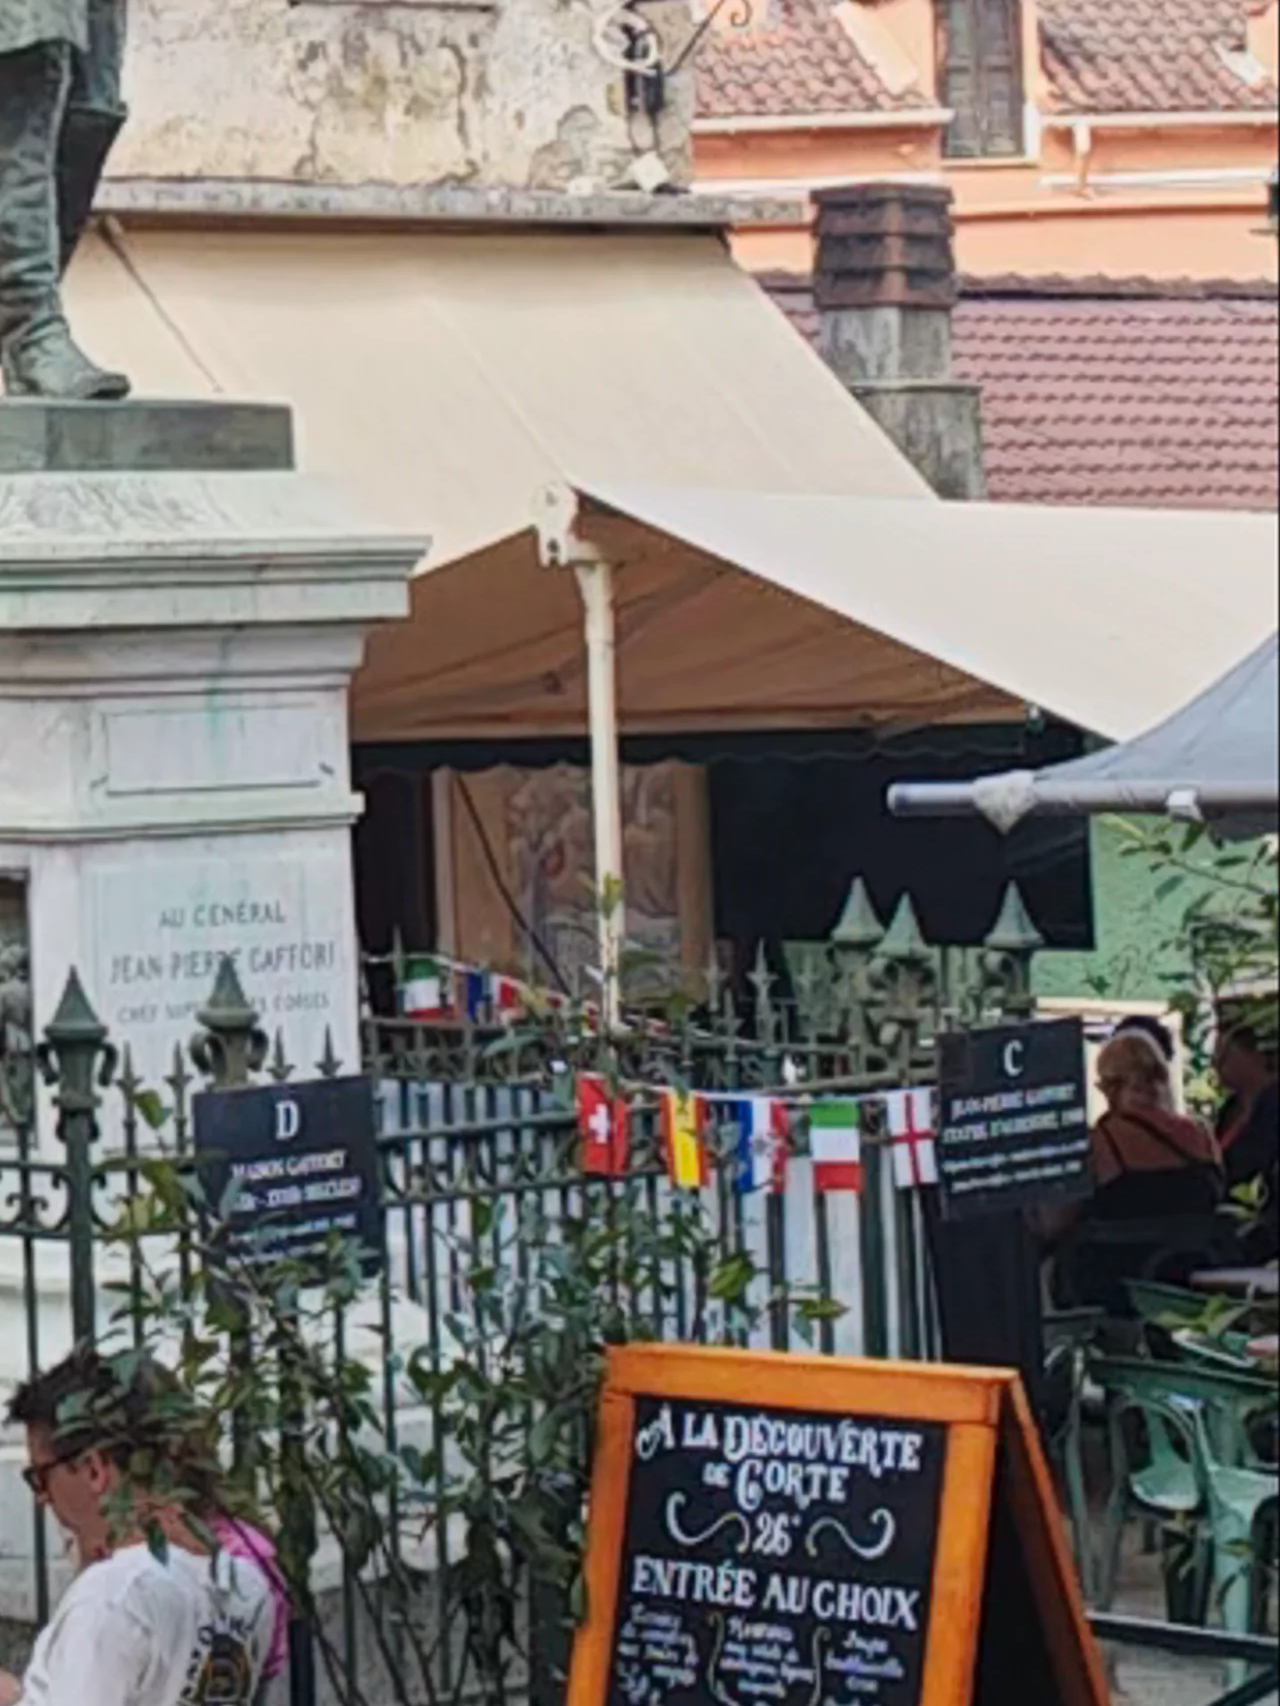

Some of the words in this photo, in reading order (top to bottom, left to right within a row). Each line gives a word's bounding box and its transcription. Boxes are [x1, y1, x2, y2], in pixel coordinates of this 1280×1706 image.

[1003, 1038, 1025, 1077] C
[275, 1099, 300, 1141] D
[681, 1411, 720, 1449] LA
[736, 1458, 850, 1511] CORTE
[631, 1555, 757, 1608] ENTRÉE
[762, 1572, 811, 1615] AU
[811, 1580, 921, 1631] CHOIX
